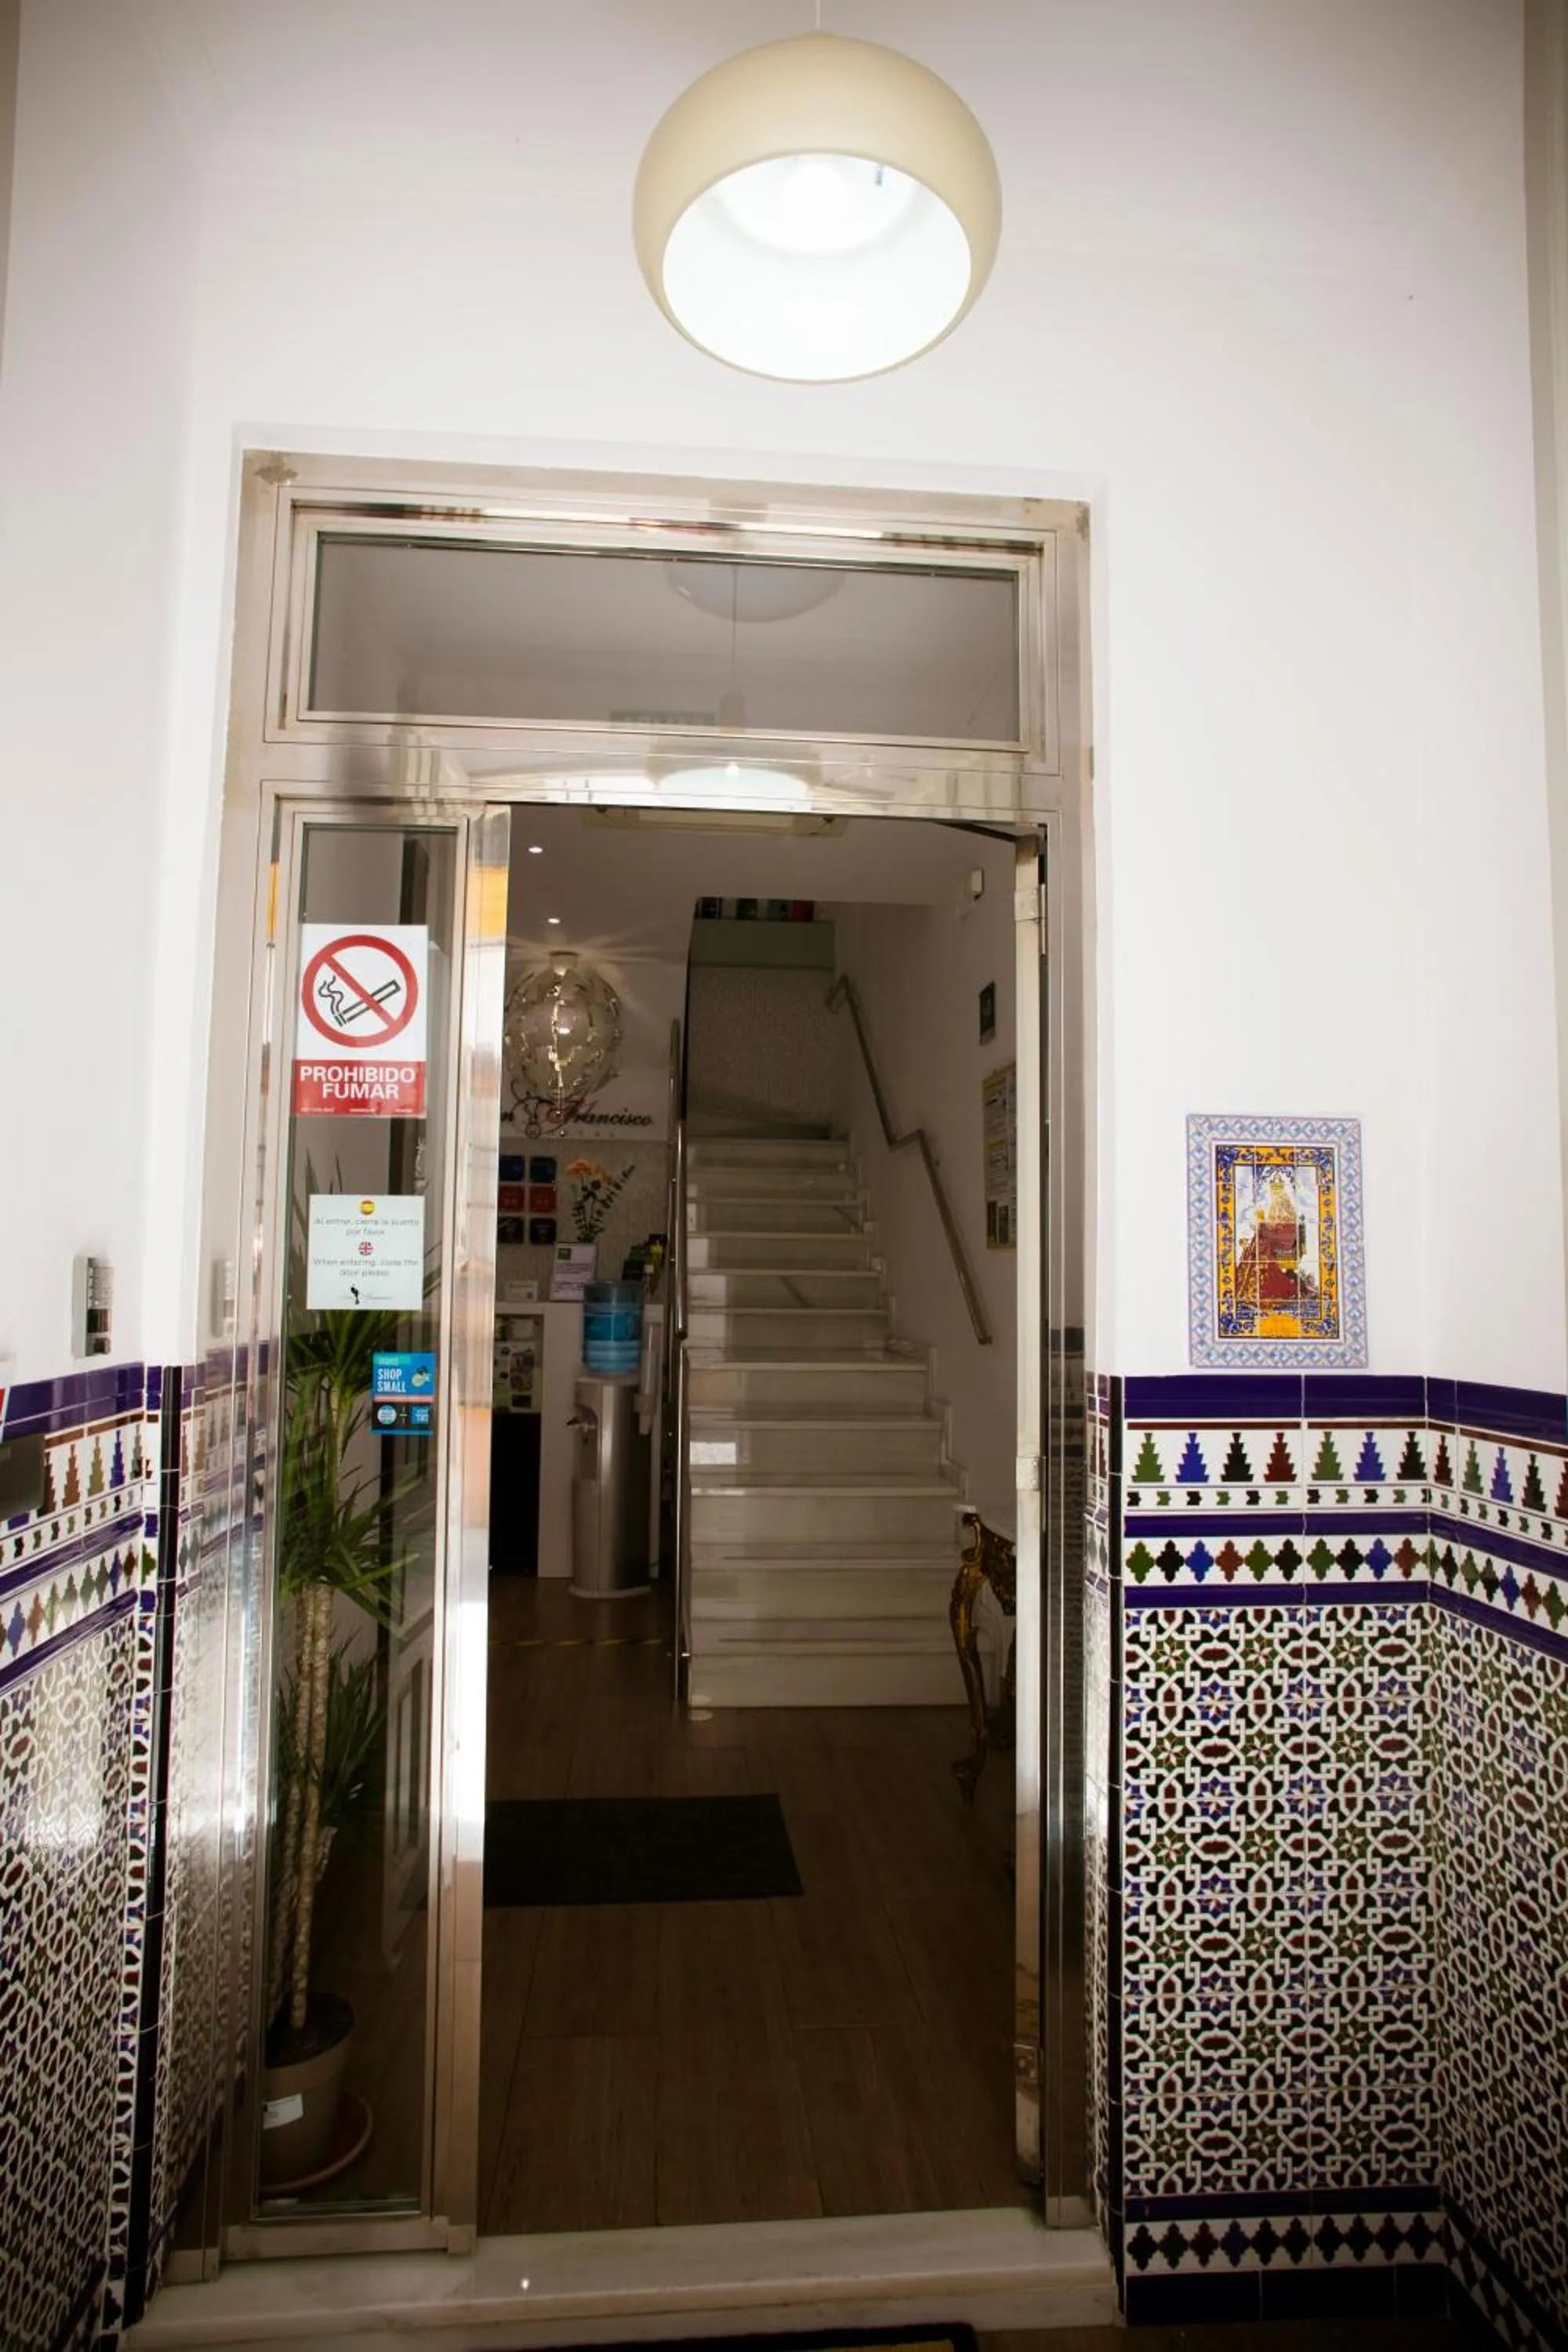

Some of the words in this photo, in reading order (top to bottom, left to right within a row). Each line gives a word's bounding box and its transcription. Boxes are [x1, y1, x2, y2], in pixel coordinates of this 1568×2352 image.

[300, 1065, 416, 1083] PROHIBIDO
[322, 1083, 400, 1099] FUMAR
[377, 1368, 402, 1381] SHOP
[377, 1381, 407, 1393] SMALL
